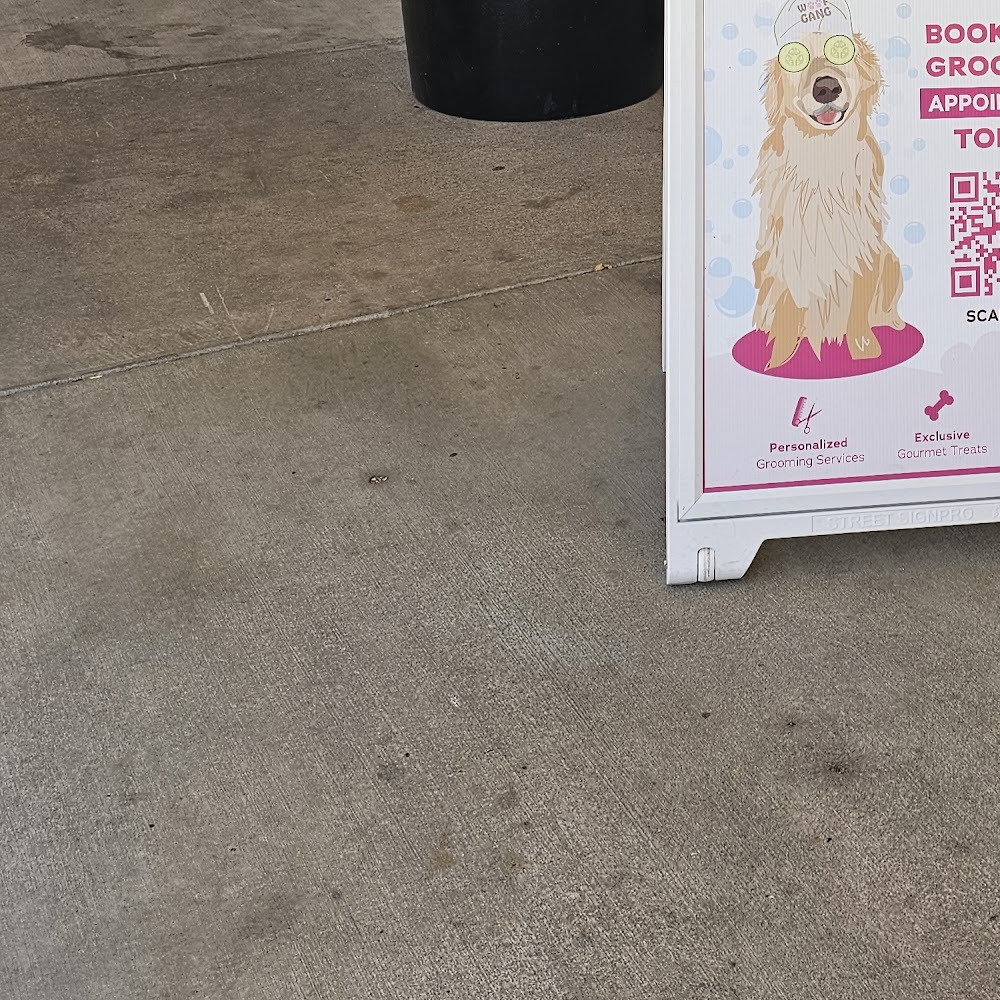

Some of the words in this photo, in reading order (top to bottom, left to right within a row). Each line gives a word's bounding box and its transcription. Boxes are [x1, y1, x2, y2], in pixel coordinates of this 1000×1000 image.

[800, 6, 832, 24] GANG
[914, 429, 970, 442] Exclusive
[769, 437, 848, 453] Personalized
[897, 446, 948, 460] Gourmet
[949, 443, 988, 456] Treats
[756, 455, 814, 470] Grooming
[815, 452, 865, 466] Services
[827, 513, 893, 531] STREET
